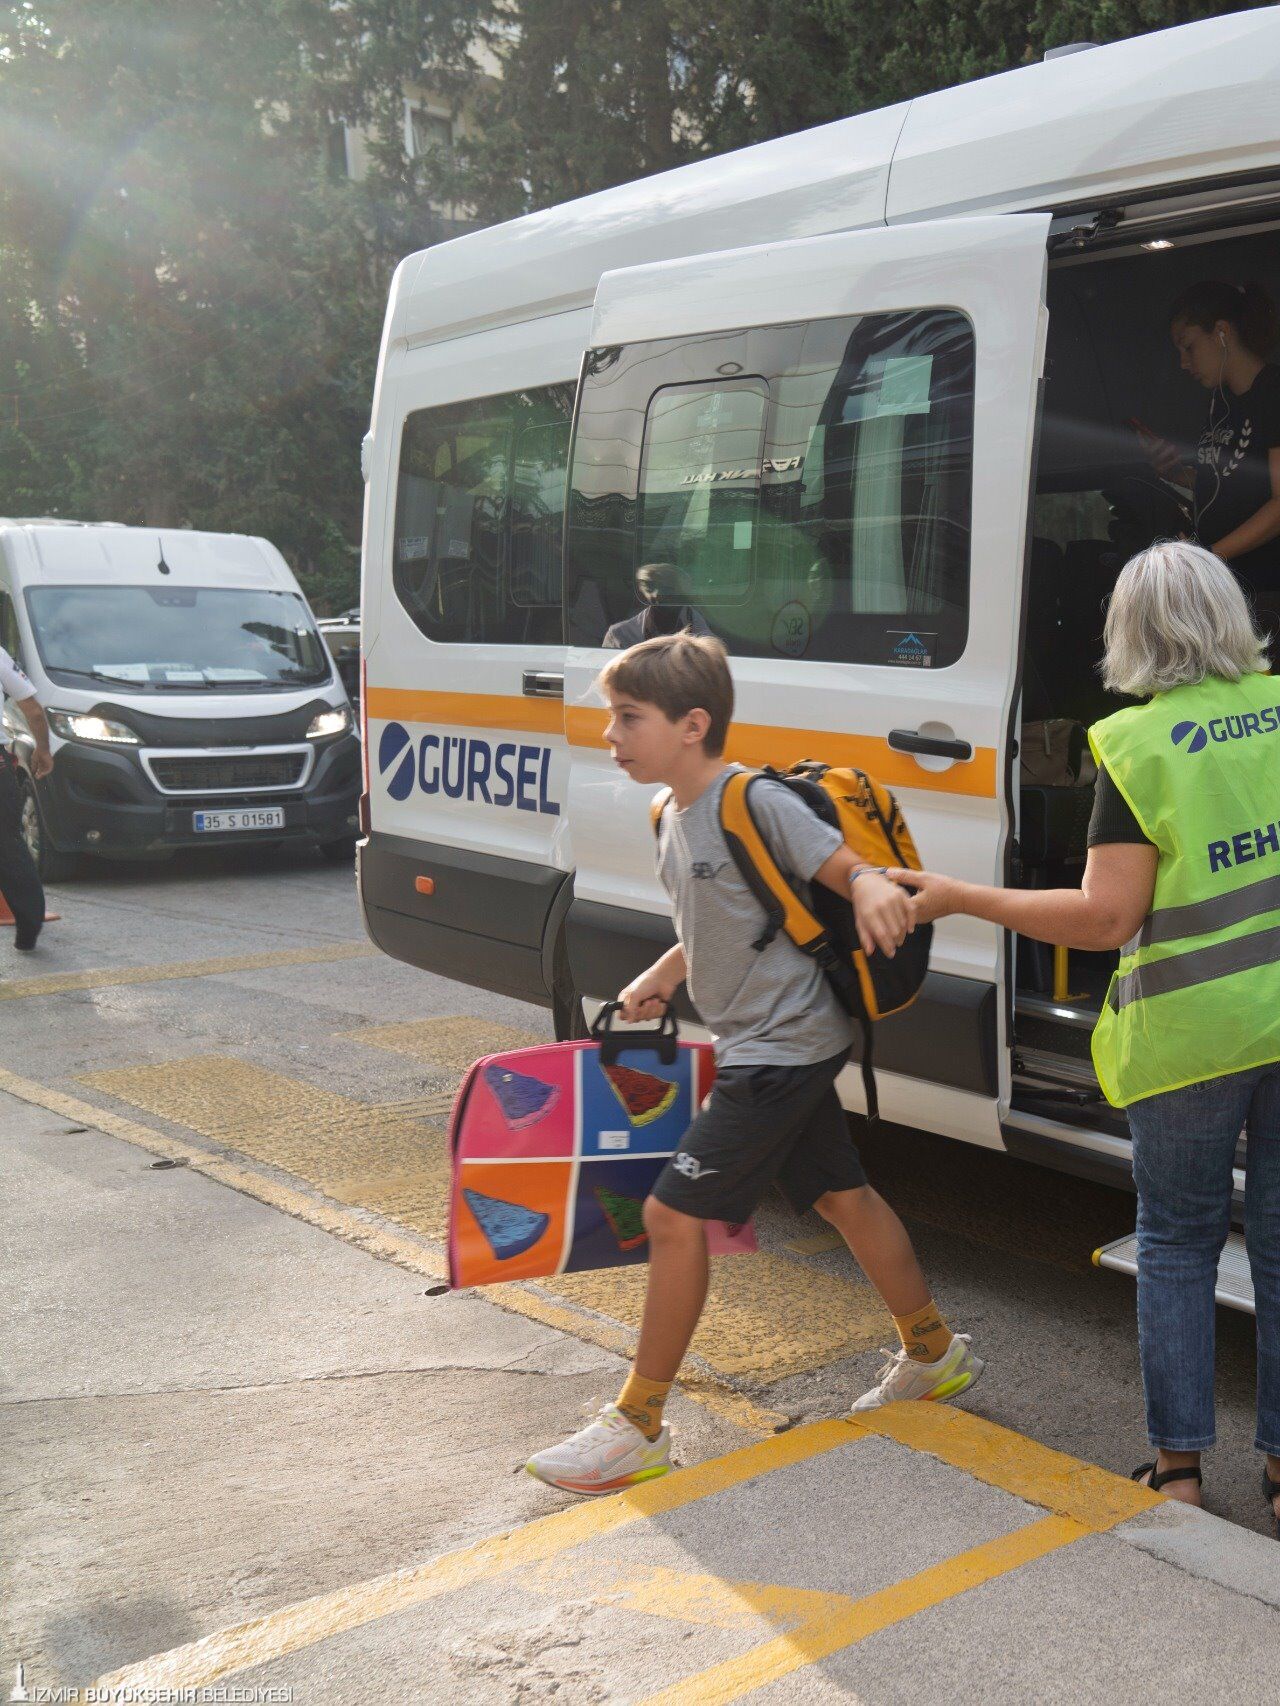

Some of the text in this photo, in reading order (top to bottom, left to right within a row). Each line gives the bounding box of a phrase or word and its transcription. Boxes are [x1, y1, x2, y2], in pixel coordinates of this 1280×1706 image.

[418, 734, 561, 816] GÜRSEL
[205, 813, 281, 829] 35 S 01581
